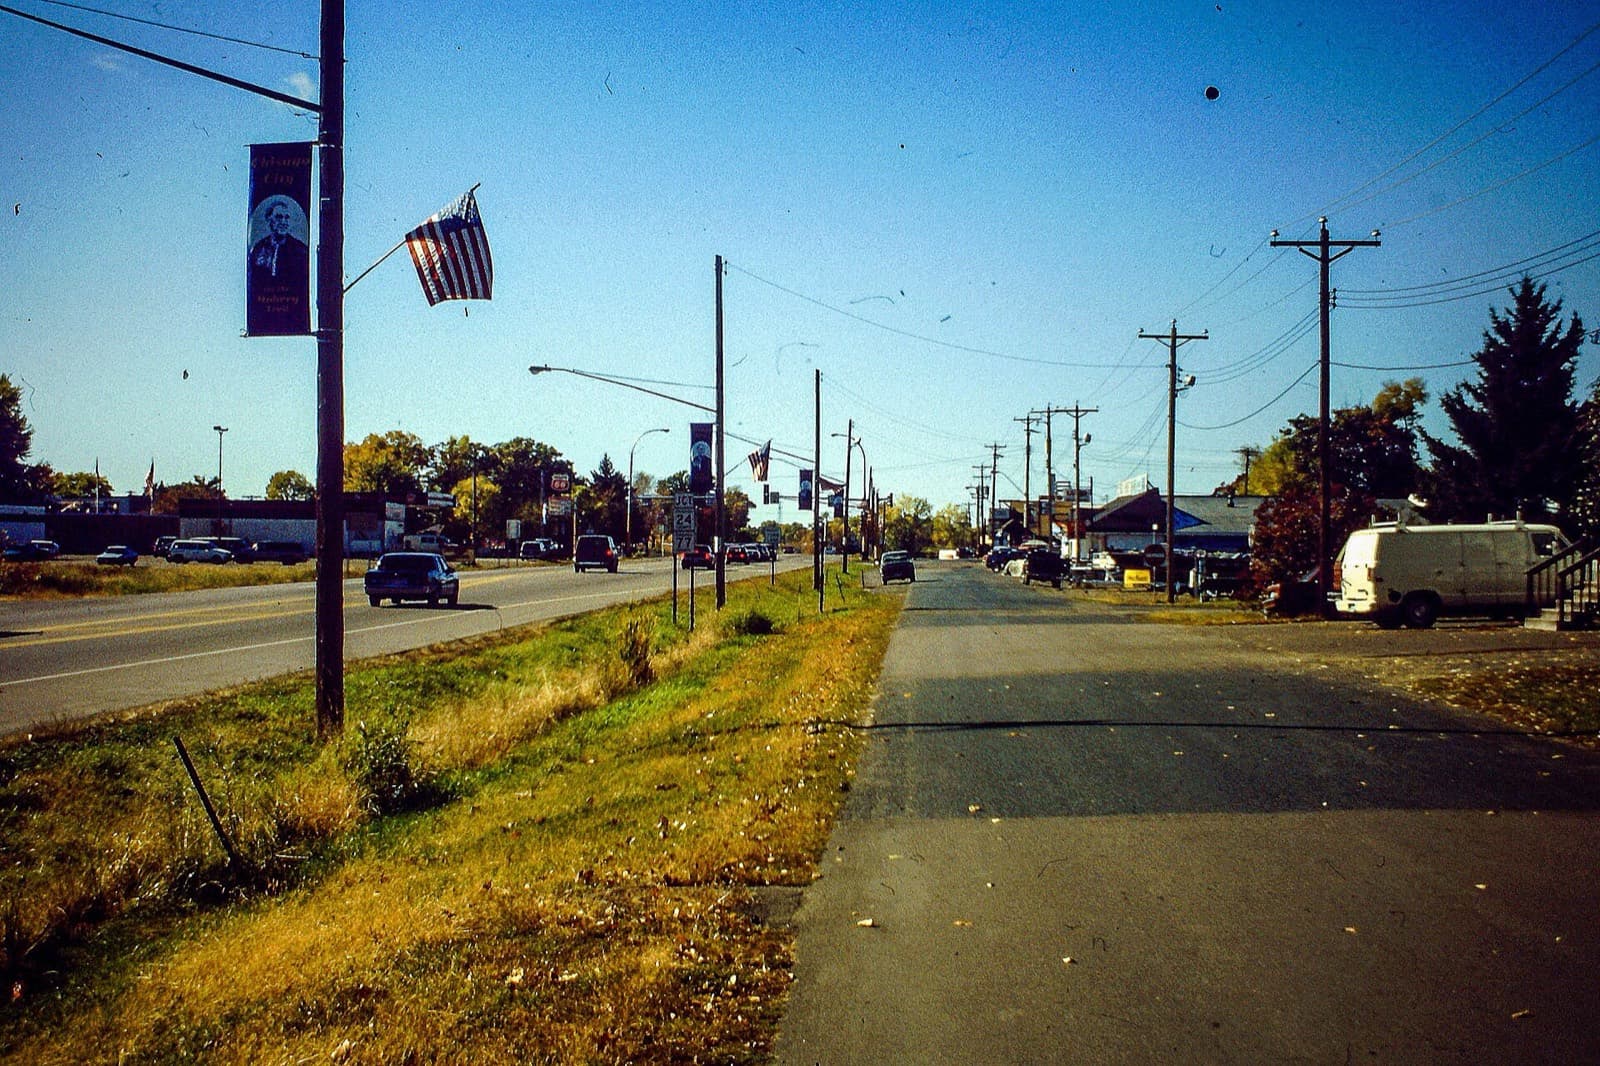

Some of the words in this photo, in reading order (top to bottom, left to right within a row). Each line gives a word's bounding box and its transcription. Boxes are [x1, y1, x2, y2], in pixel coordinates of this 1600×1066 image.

[264, 173, 294, 185] City
[554, 481, 566, 489] 66
[676, 494, 694, 506] JCT
[677, 514, 692, 525] 24
[677, 537, 691, 548] 77
